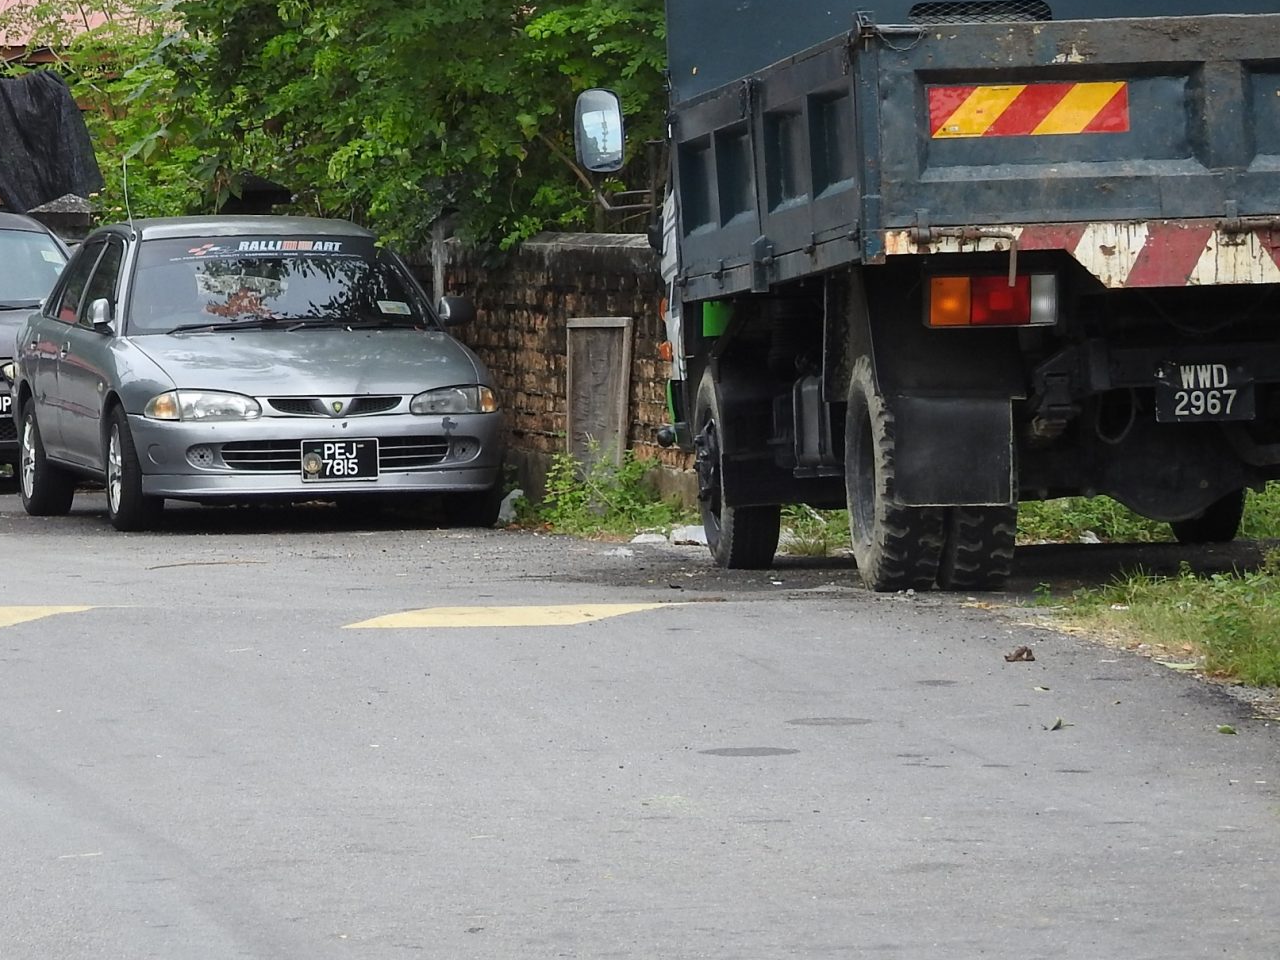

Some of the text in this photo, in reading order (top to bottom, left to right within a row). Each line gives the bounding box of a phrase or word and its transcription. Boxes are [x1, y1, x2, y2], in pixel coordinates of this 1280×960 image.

[1179, 363, 1229, 389] WWD
[1174, 389, 1238, 416] 2967
[323, 442, 357, 460] PEJ
[322, 459, 359, 476] 7815
